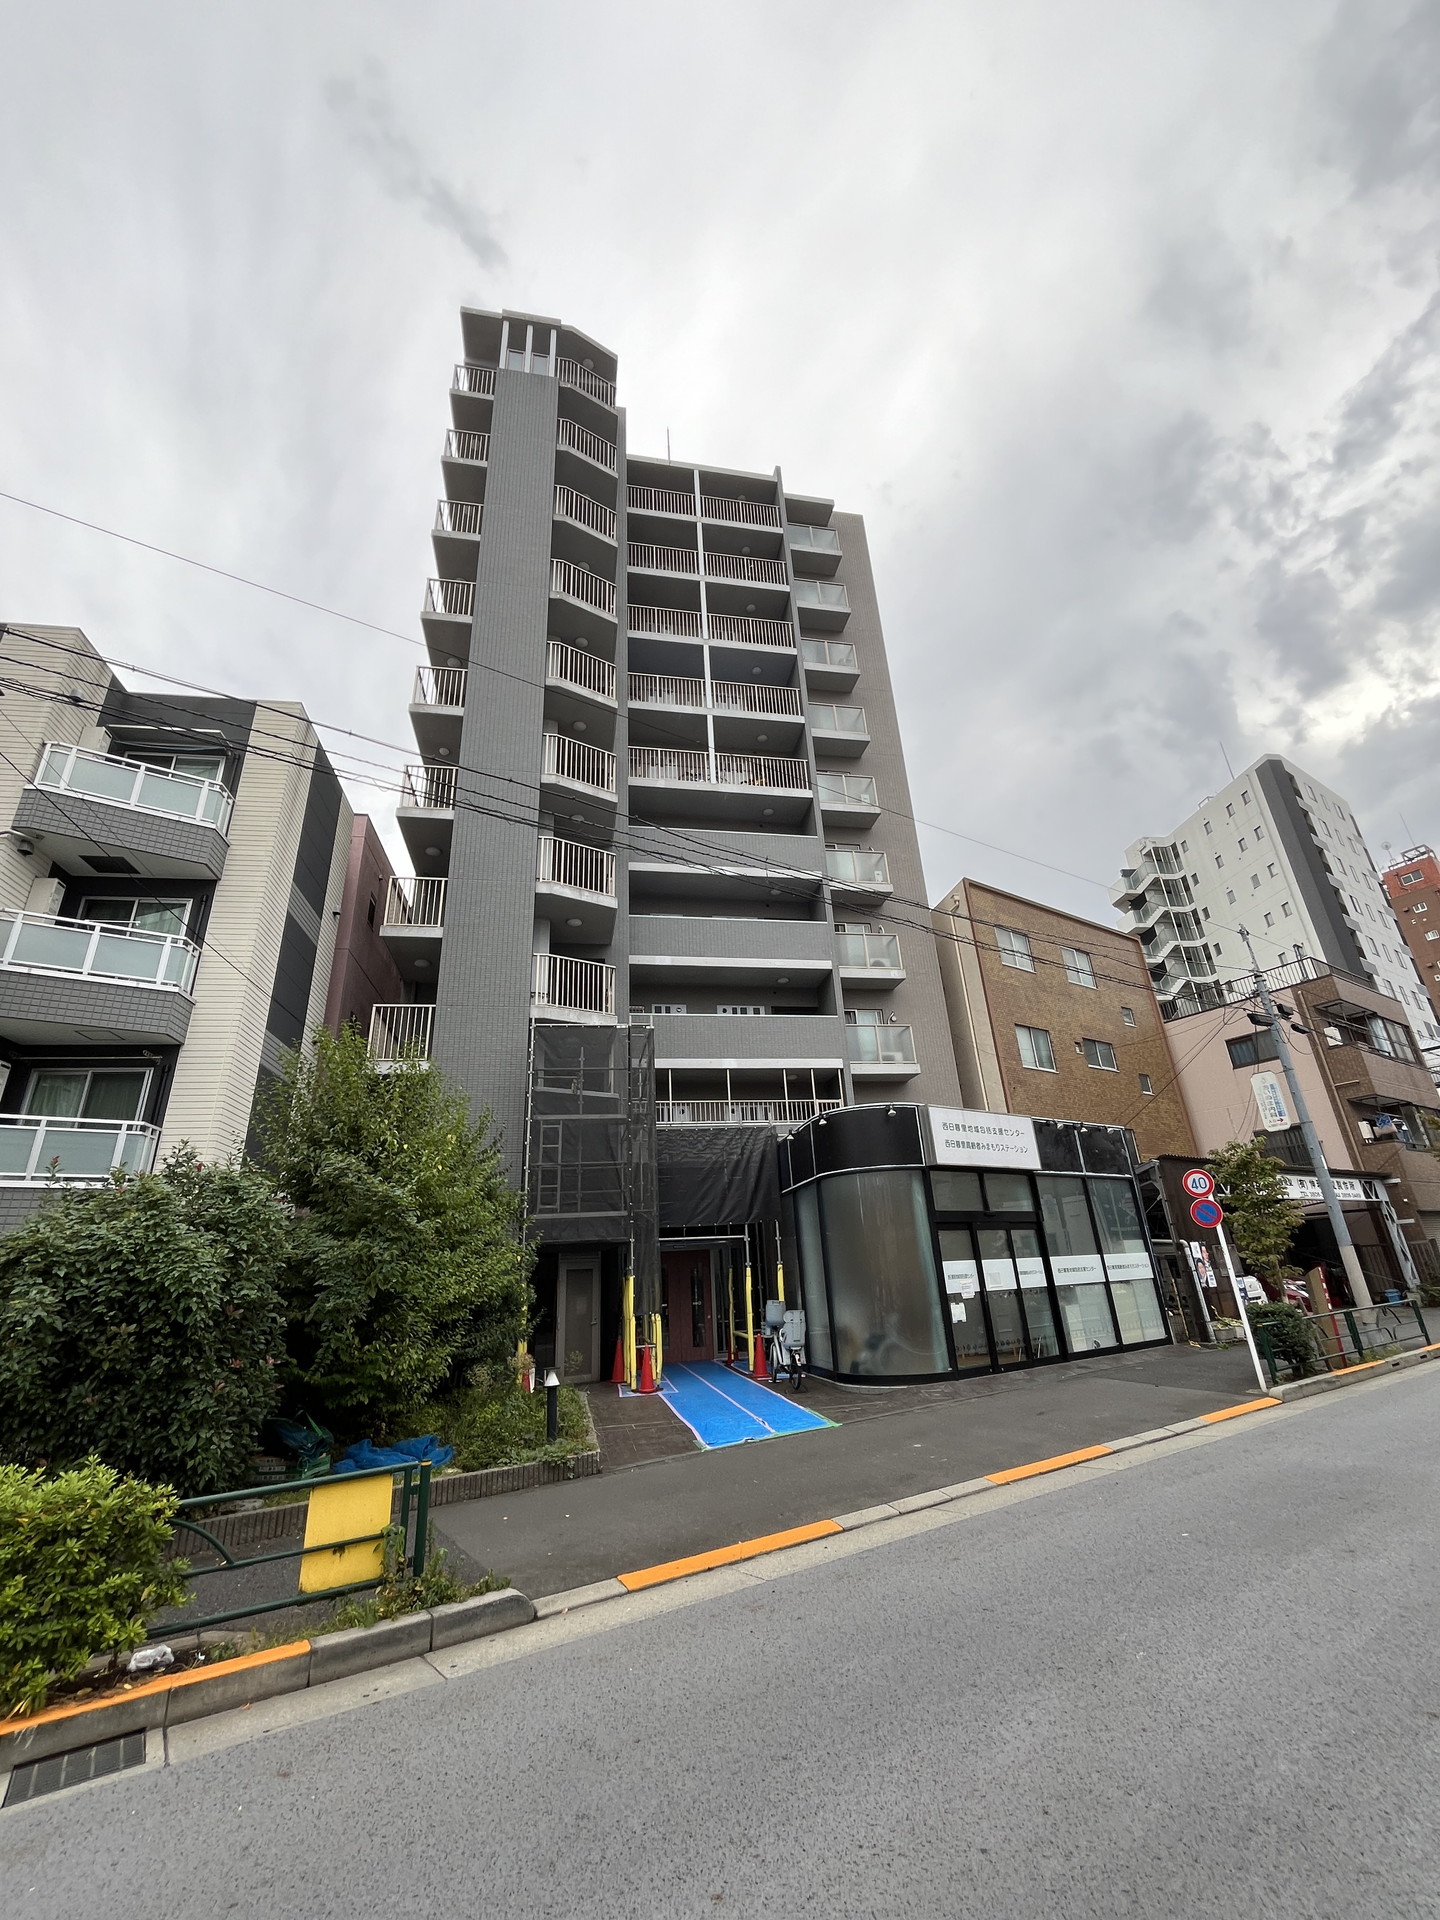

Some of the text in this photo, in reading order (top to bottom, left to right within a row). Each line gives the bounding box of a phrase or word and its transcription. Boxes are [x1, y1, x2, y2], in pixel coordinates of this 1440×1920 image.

[942, 1122, 1025, 1136] 西日暮里地域包括支援センター
[945, 1139, 1028, 1153] 西日暮里高齢者みまもりステーション
[1191, 1177, 1207, 1189] 40
